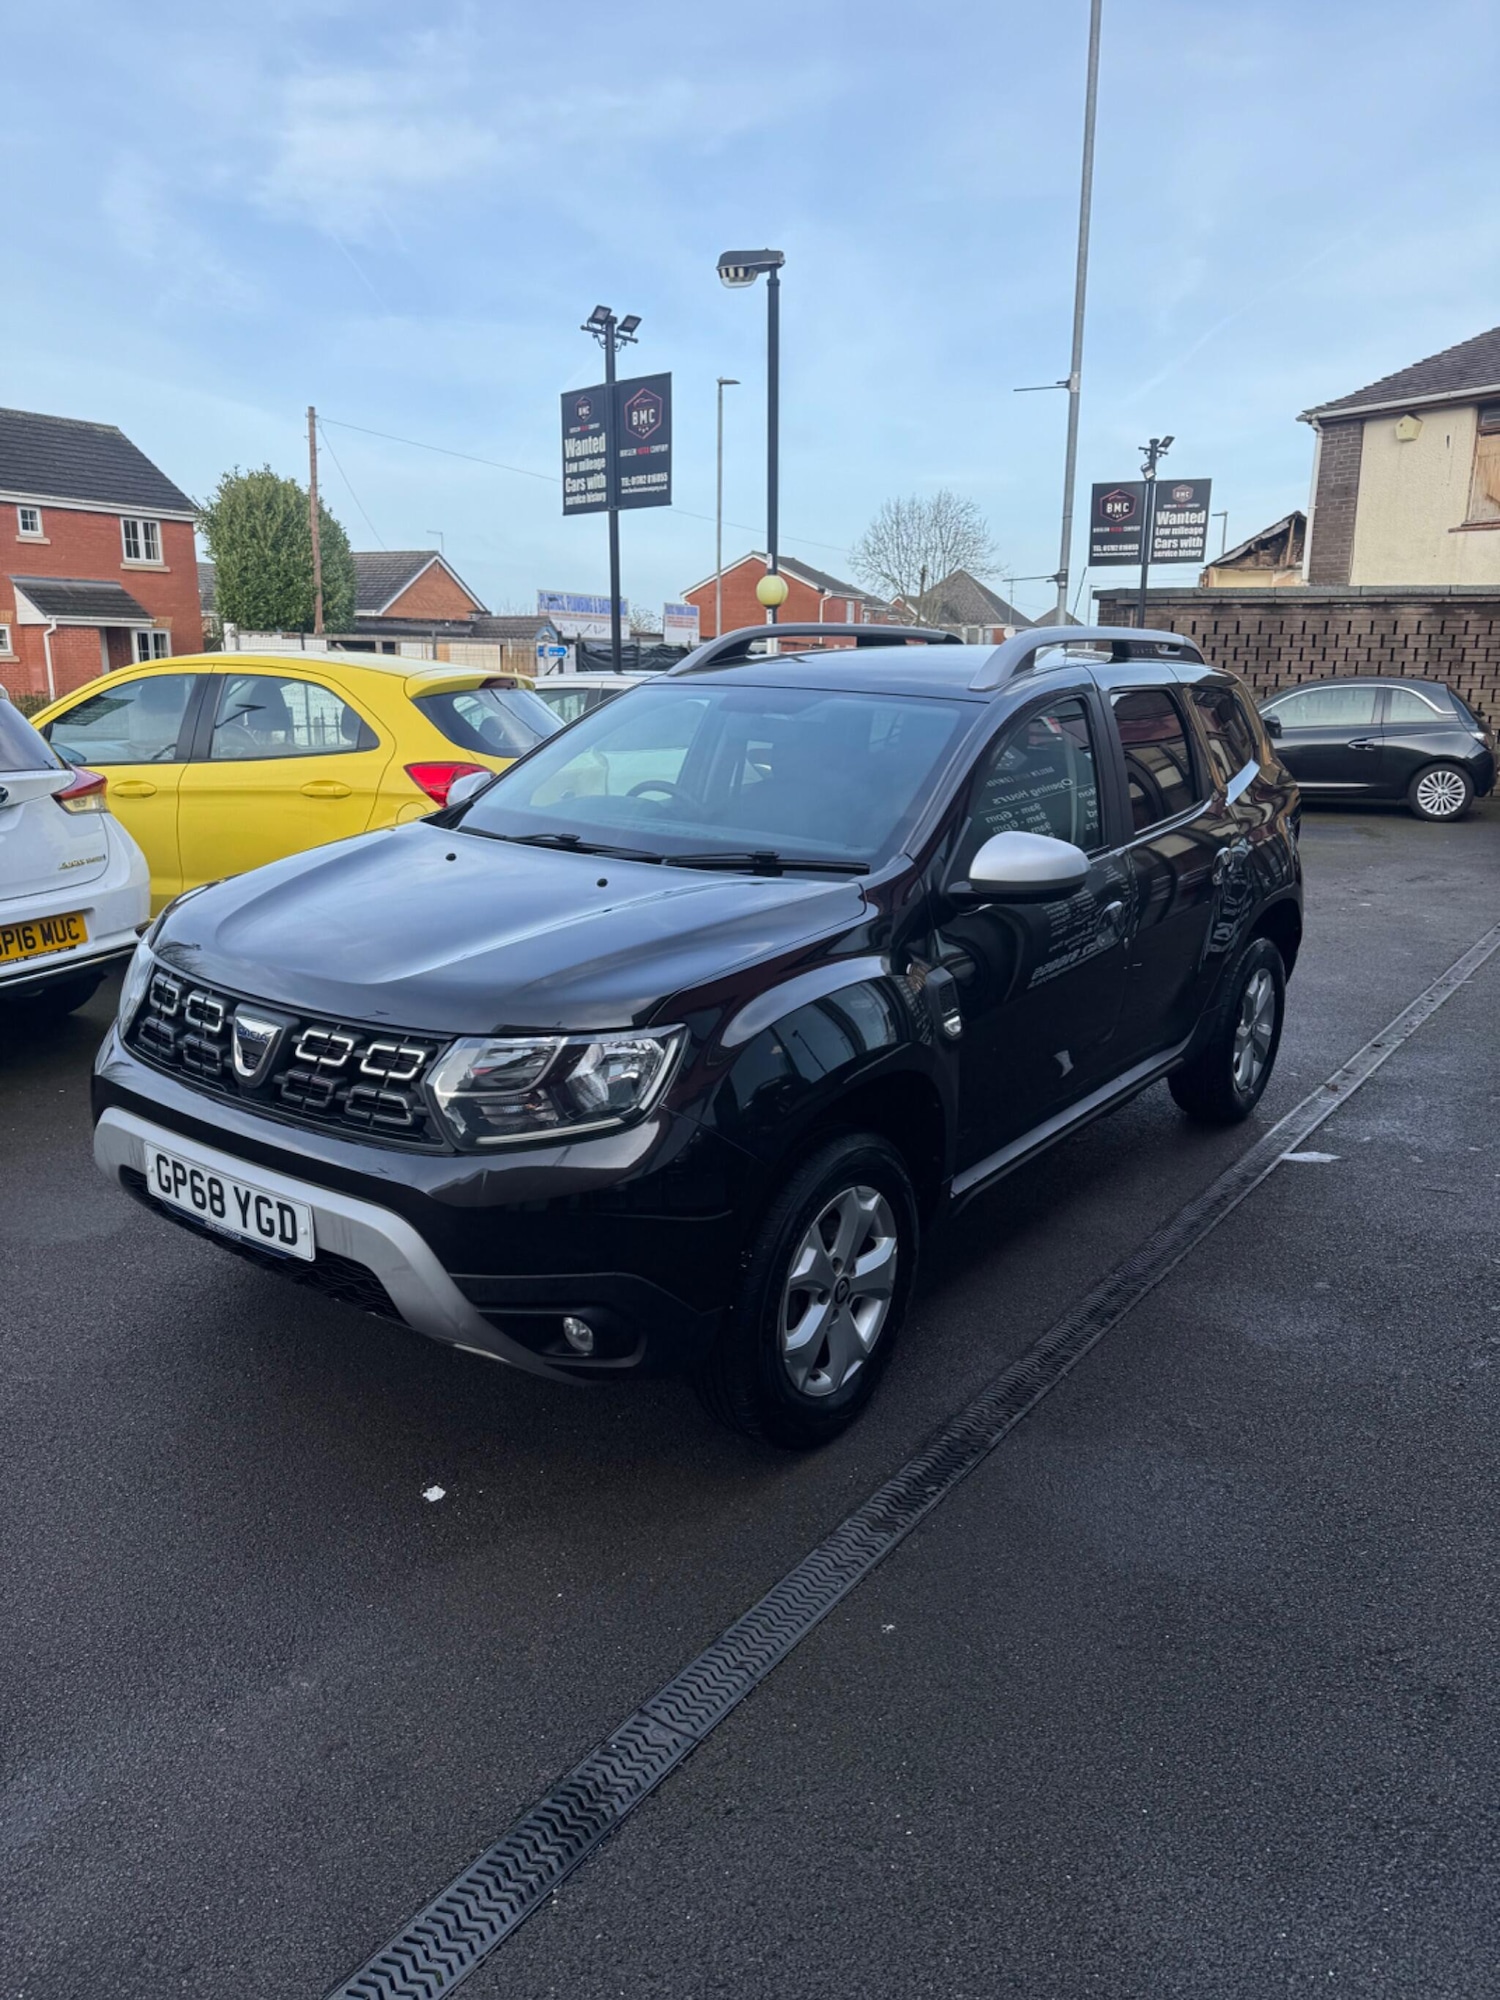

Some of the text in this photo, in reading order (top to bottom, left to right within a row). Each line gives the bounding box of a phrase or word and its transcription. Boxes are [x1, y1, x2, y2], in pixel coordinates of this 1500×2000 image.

[632, 408, 656, 426] BMC
[565, 433, 606, 458] Wanted
[565, 457, 606, 474] Low mileage
[565, 476, 586, 493] Cars
[586, 472, 606, 489] with
[565, 491, 606, 506] service history
[1106, 502, 1129, 513] BMC
[1156, 510, 1206, 525] Wanted
[1155, 525, 1204, 536] Low mileage
[1154, 536, 1203, 549] Cars with
[1153, 549, 1202, 558] service history
[39, 917, 80, 947] MUC
[156, 1153, 298, 1246] GP68 YGD
